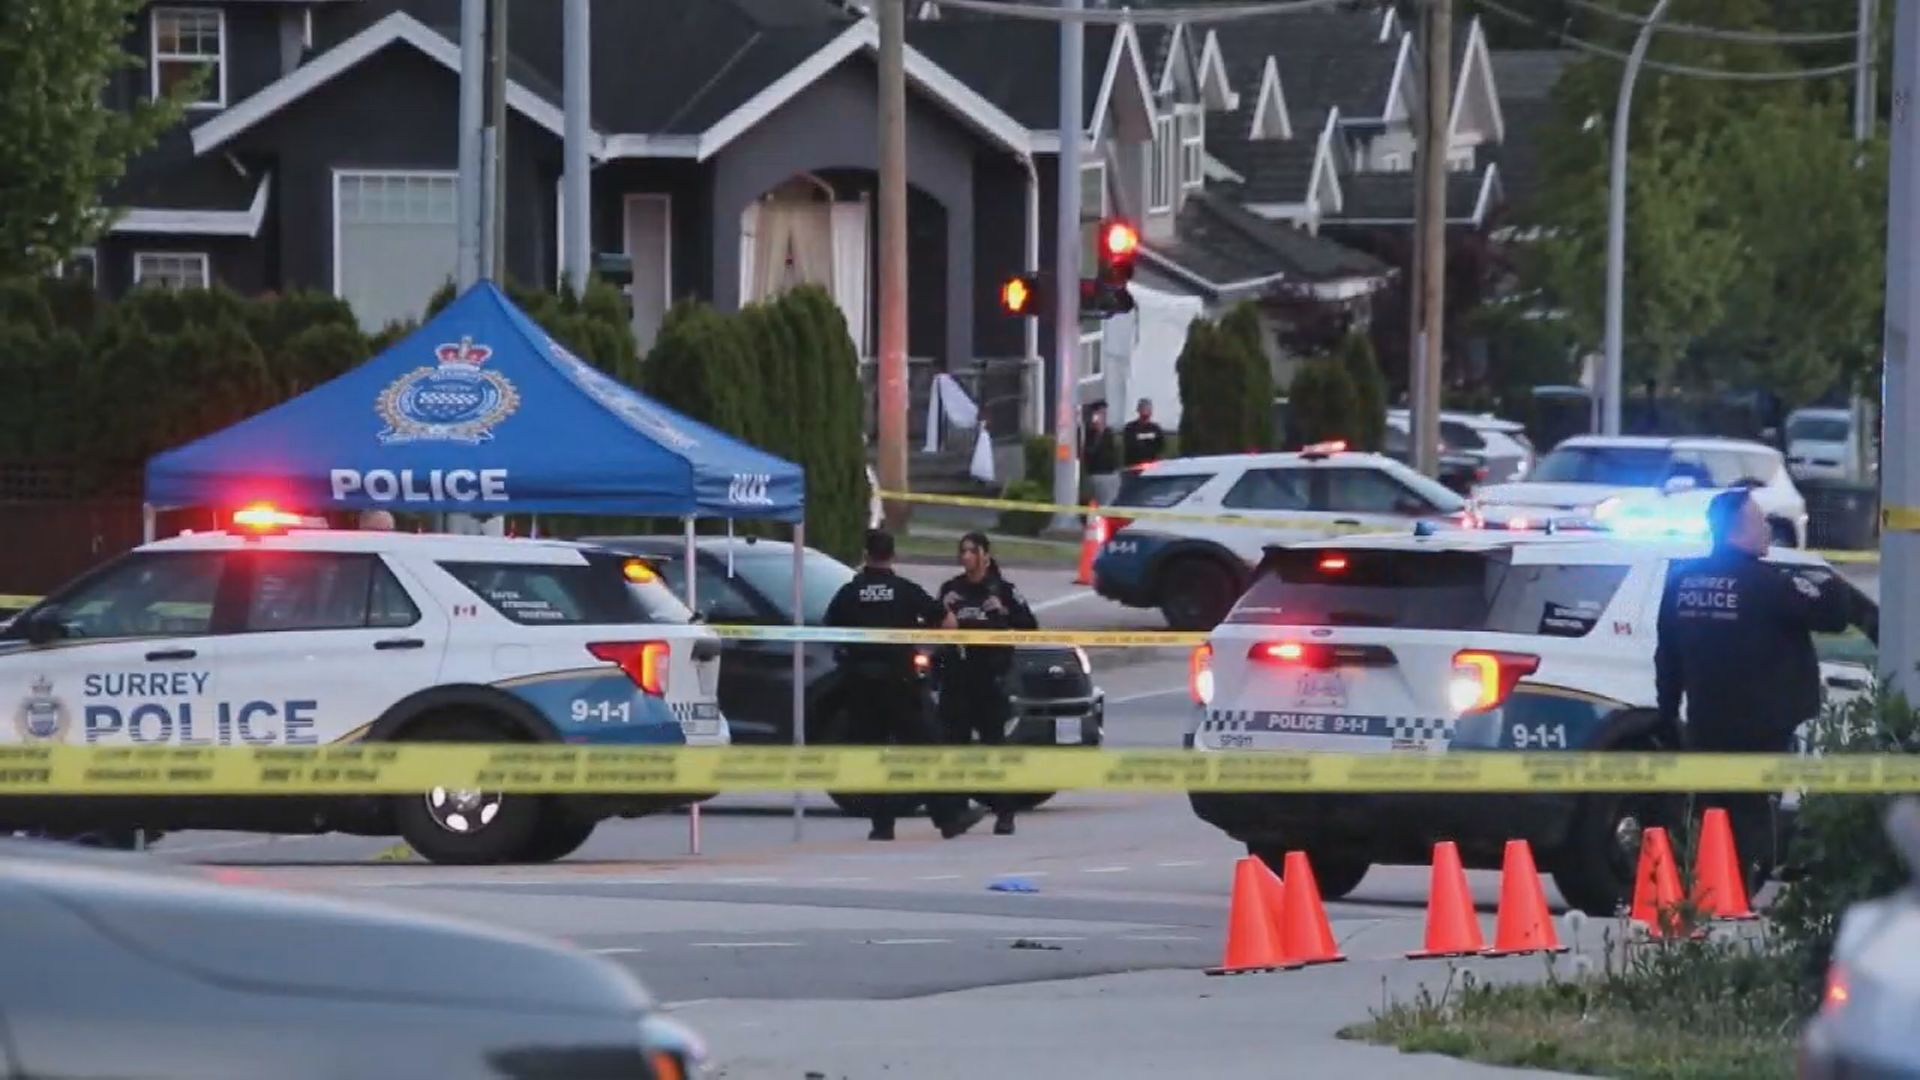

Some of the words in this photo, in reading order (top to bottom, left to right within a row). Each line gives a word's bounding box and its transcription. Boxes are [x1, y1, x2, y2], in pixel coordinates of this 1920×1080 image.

[330, 468, 510, 501] POLICE
[1677, 592, 1738, 609] POLICE
[84, 672, 210, 697] SURREY
[84, 700, 318, 745] POLICE
[571, 699, 631, 723] 9-1-1
[1267, 714, 1325, 731] POLICE
[1334, 716, 1369, 733] 9-1-1
[1512, 723, 1567, 749] 9-1-1
